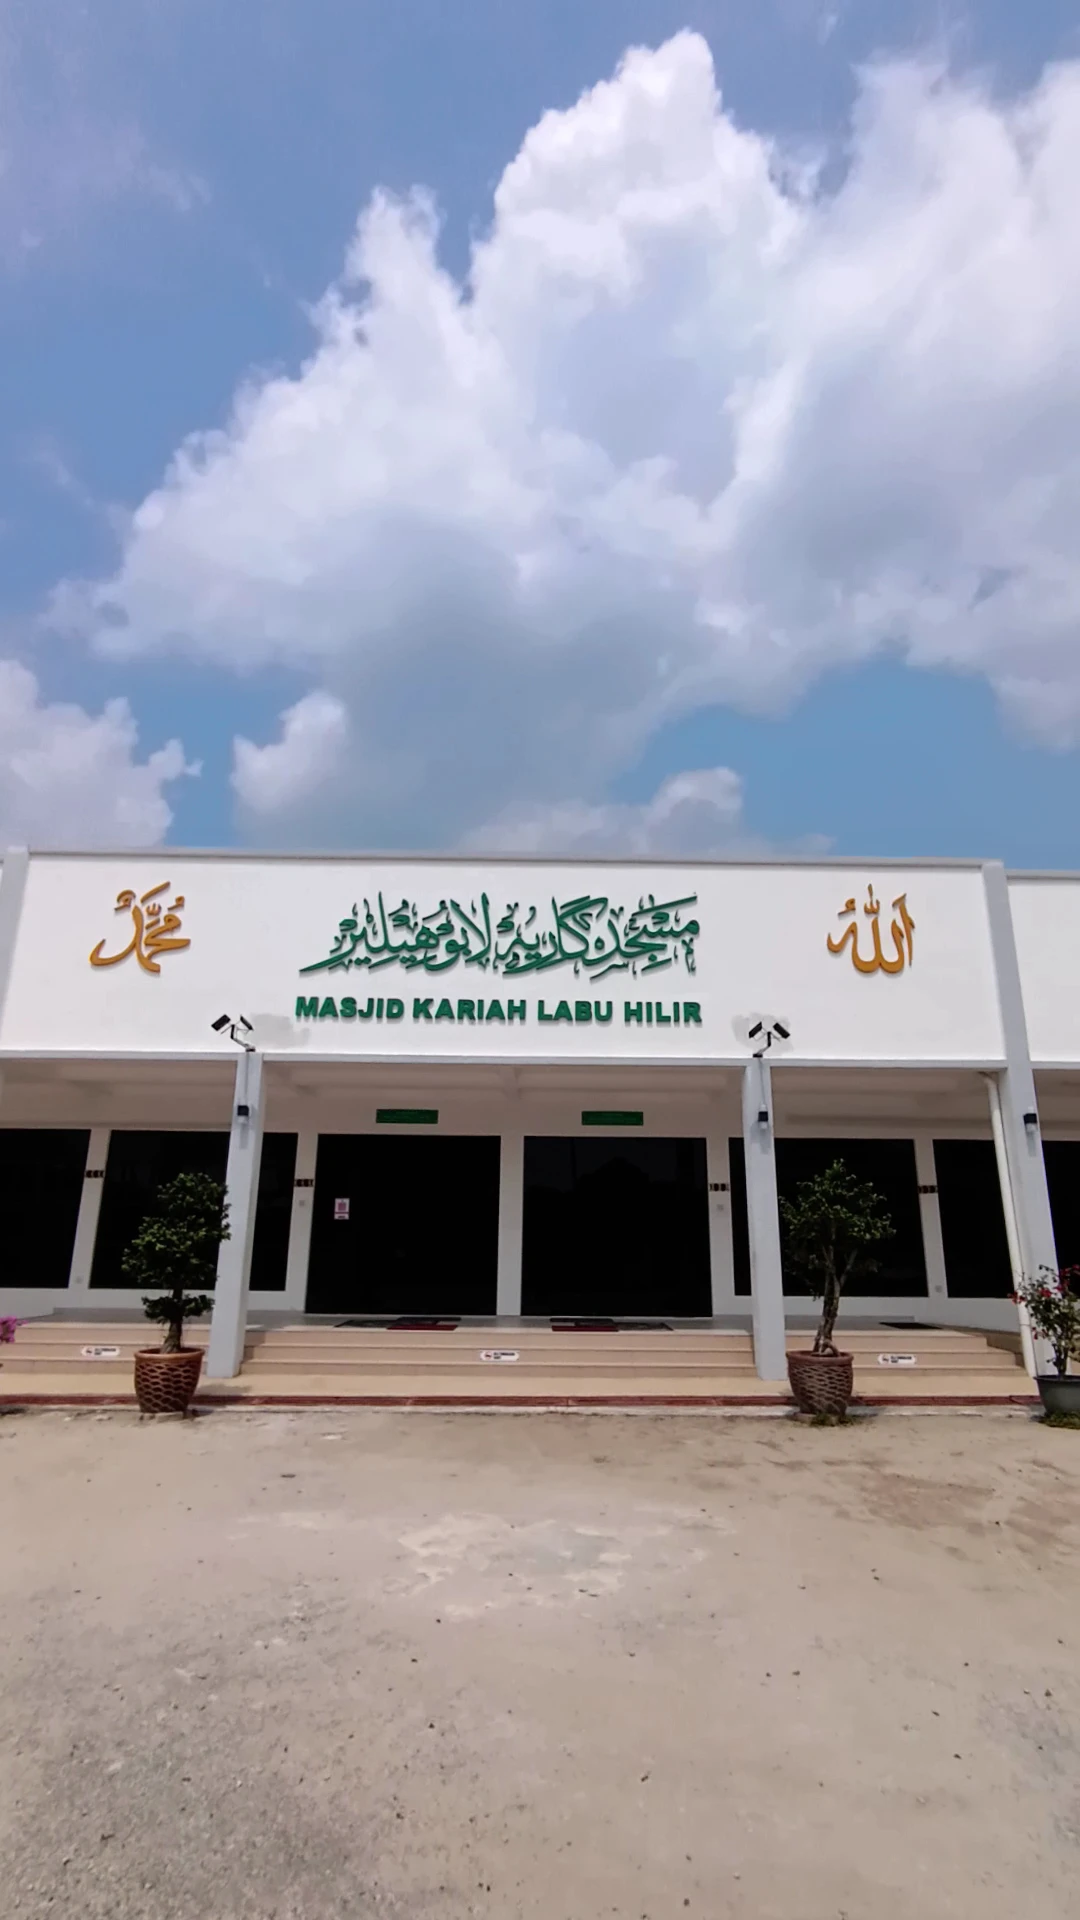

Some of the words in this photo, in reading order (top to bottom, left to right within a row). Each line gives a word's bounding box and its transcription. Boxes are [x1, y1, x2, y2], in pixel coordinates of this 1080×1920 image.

[296, 997, 404, 1019] MASJID
[413, 998, 526, 1020] KARIAH
[538, 1000, 613, 1022] LABU
[625, 1001, 702, 1023] HILIR
